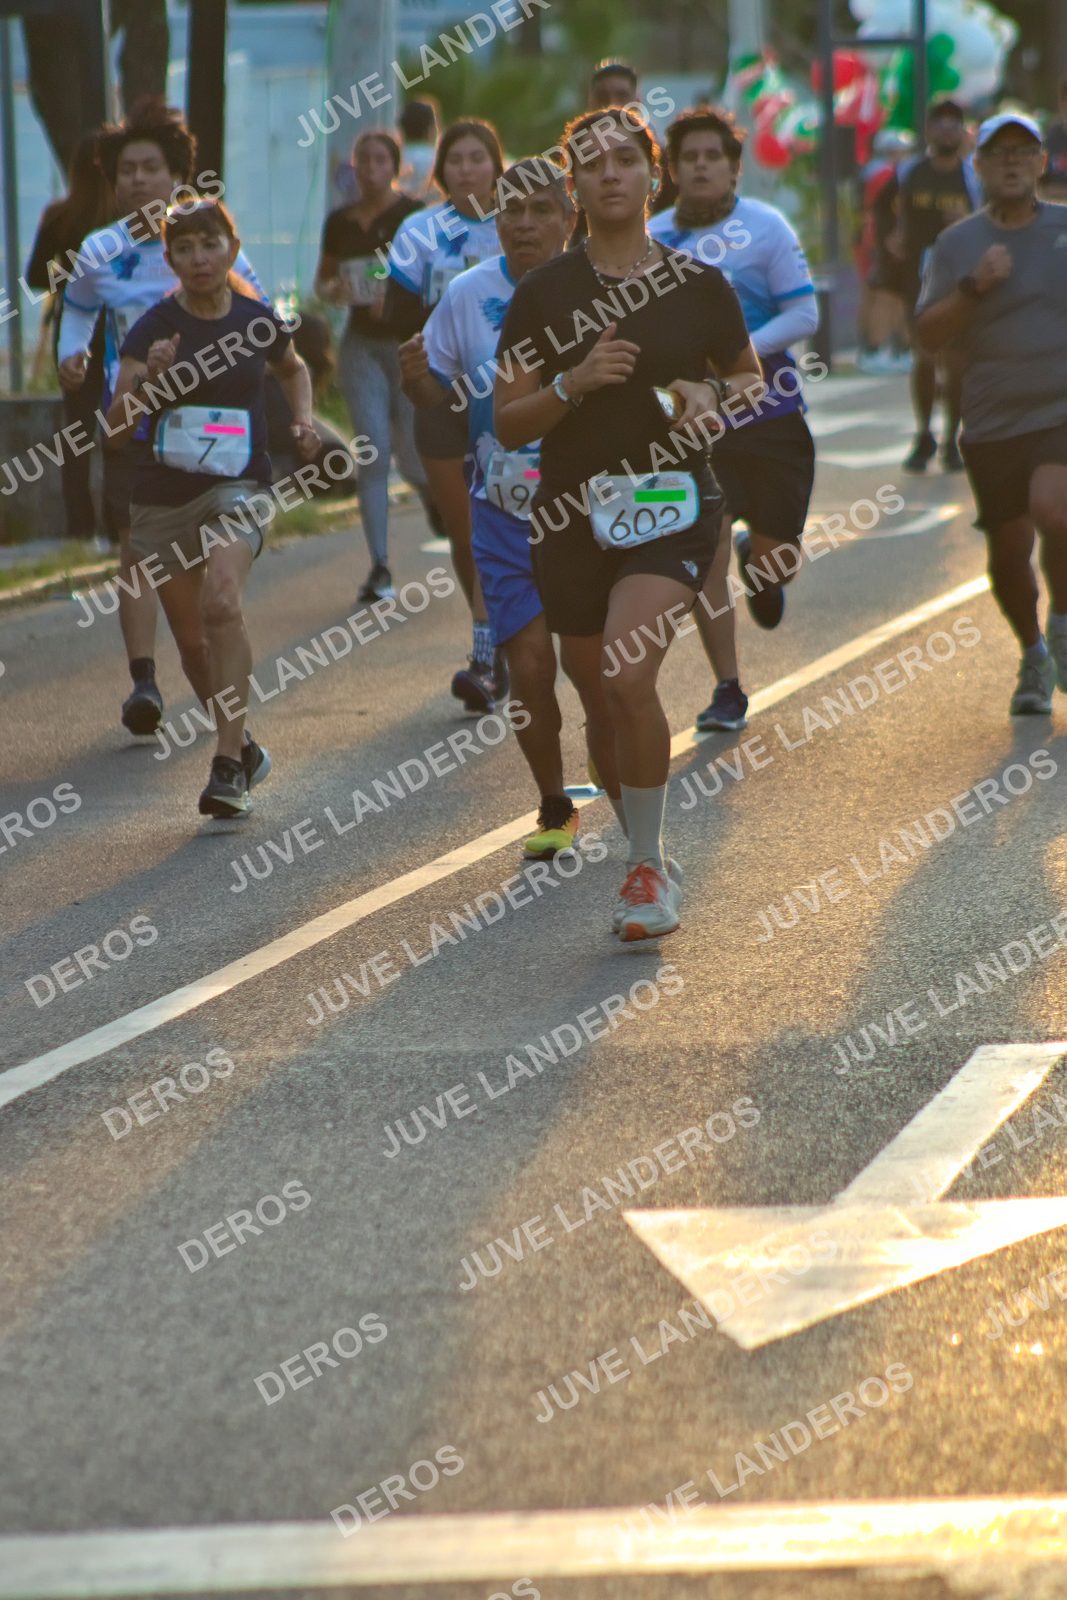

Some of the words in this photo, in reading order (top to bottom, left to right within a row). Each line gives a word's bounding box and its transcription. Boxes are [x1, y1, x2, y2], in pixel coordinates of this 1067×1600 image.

[198, 437, 217, 465] 7
[493, 484, 540, 511] 19
[609, 506, 680, 541] 602
